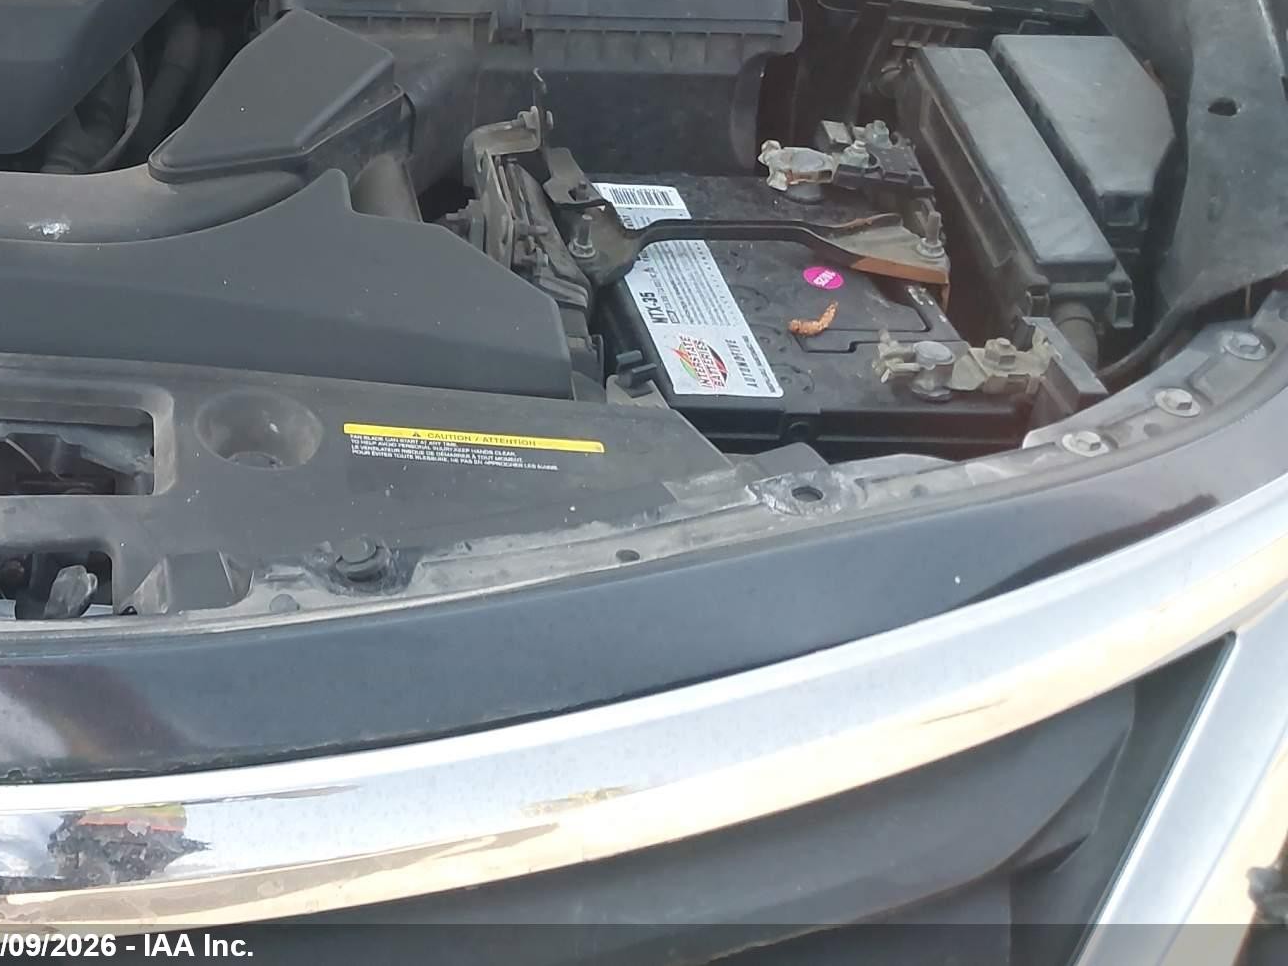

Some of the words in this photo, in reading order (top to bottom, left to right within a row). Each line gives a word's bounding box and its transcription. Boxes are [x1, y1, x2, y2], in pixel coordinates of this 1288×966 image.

[639, 292, 669, 324] MTX-35
[679, 336, 713, 388] INTERSTATE
[694, 339, 725, 387] BATTERIES
[427, 433, 472, 442] CAUTION
[482, 436, 536, 446] ATTENTION
